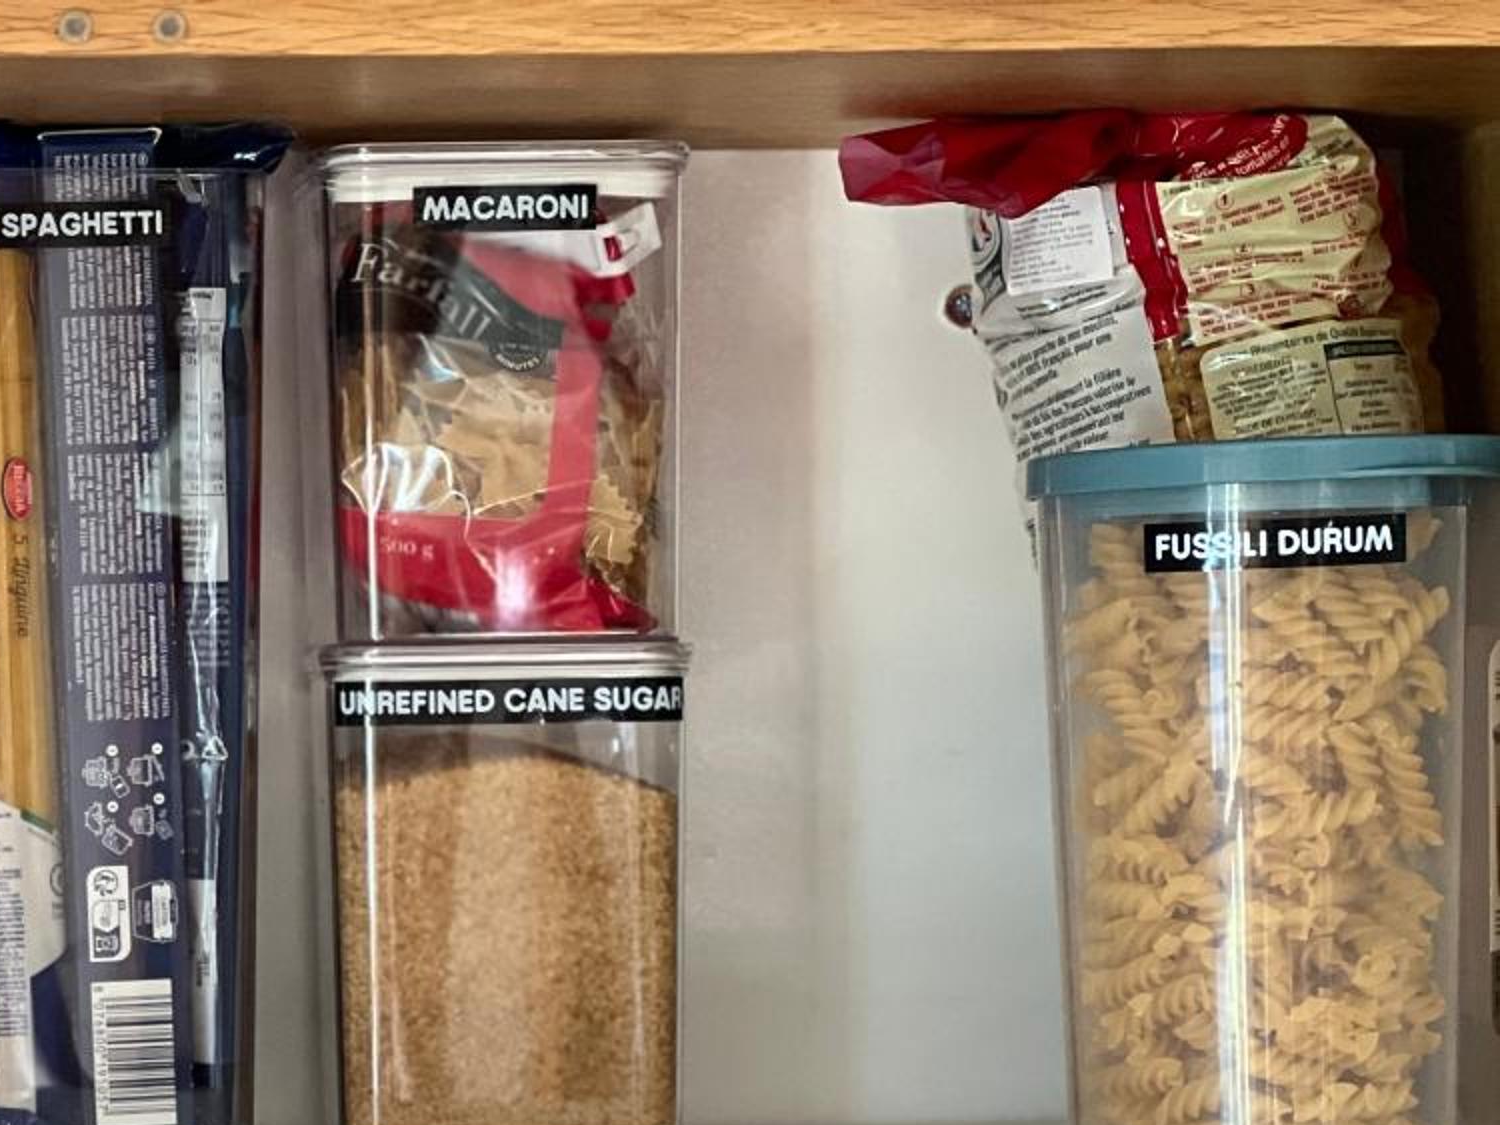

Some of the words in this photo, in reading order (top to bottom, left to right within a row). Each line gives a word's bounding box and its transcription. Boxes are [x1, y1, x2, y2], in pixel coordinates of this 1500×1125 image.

[423, 195, 589, 221] MACARONI
[1, 210, 163, 238] SPAGHETTI
[1278, 524, 1393, 556] DURUM
[339, 687, 496, 717] UNREFINED
[503, 687, 585, 716] CANE
[593, 685, 683, 713] SUGAR
